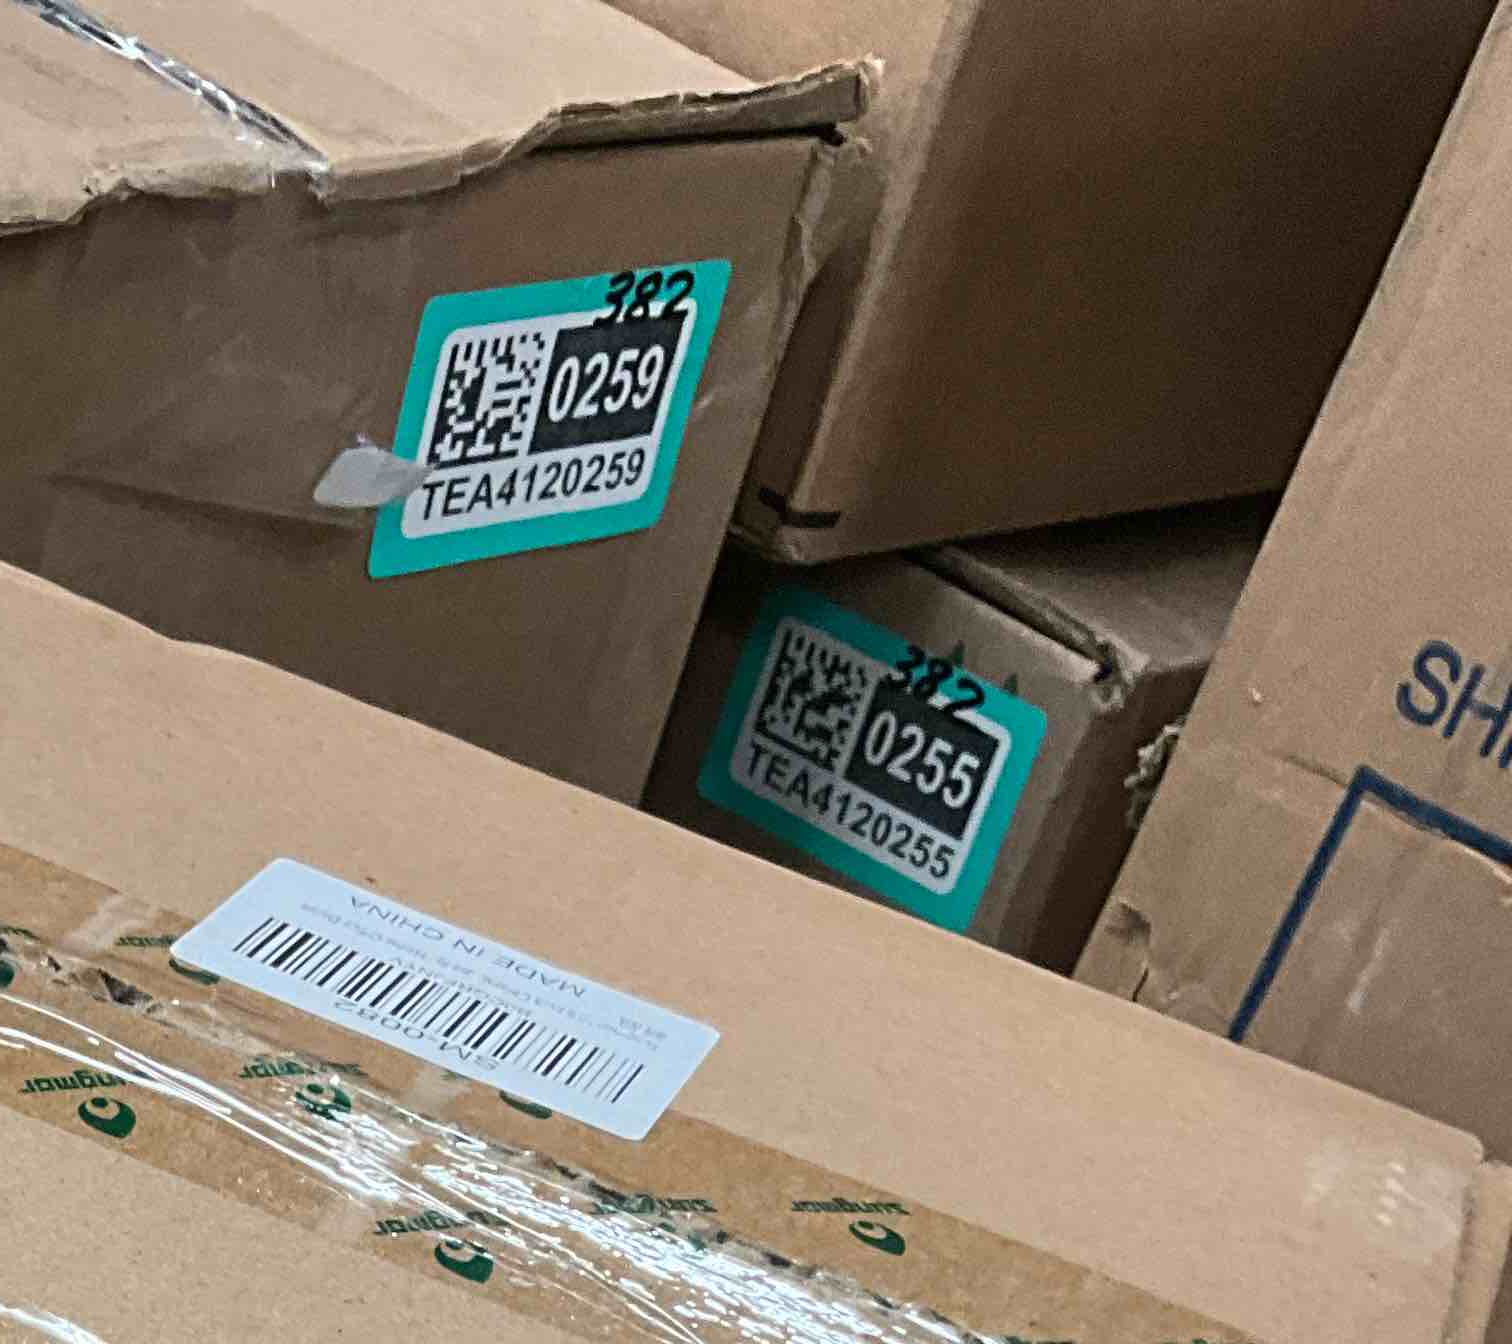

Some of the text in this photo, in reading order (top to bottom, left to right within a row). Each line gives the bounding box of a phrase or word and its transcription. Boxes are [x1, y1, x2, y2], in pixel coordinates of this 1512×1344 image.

[593, 270, 695, 328] 382
[548, 344, 665, 423] 0259
[422, 448, 646, 521] TEA4120259
[882, 644, 985, 712] 382
[1395, 639, 1512, 769] SH
[864, 711, 981, 808] 0255
[748, 743, 956, 879] TEA4120255
[343, 894, 447, 943] CHINA
[450, 936, 487, 958] IN
[492, 953, 587, 999] MADE
[332, 996, 498, 1072] SM-0082
